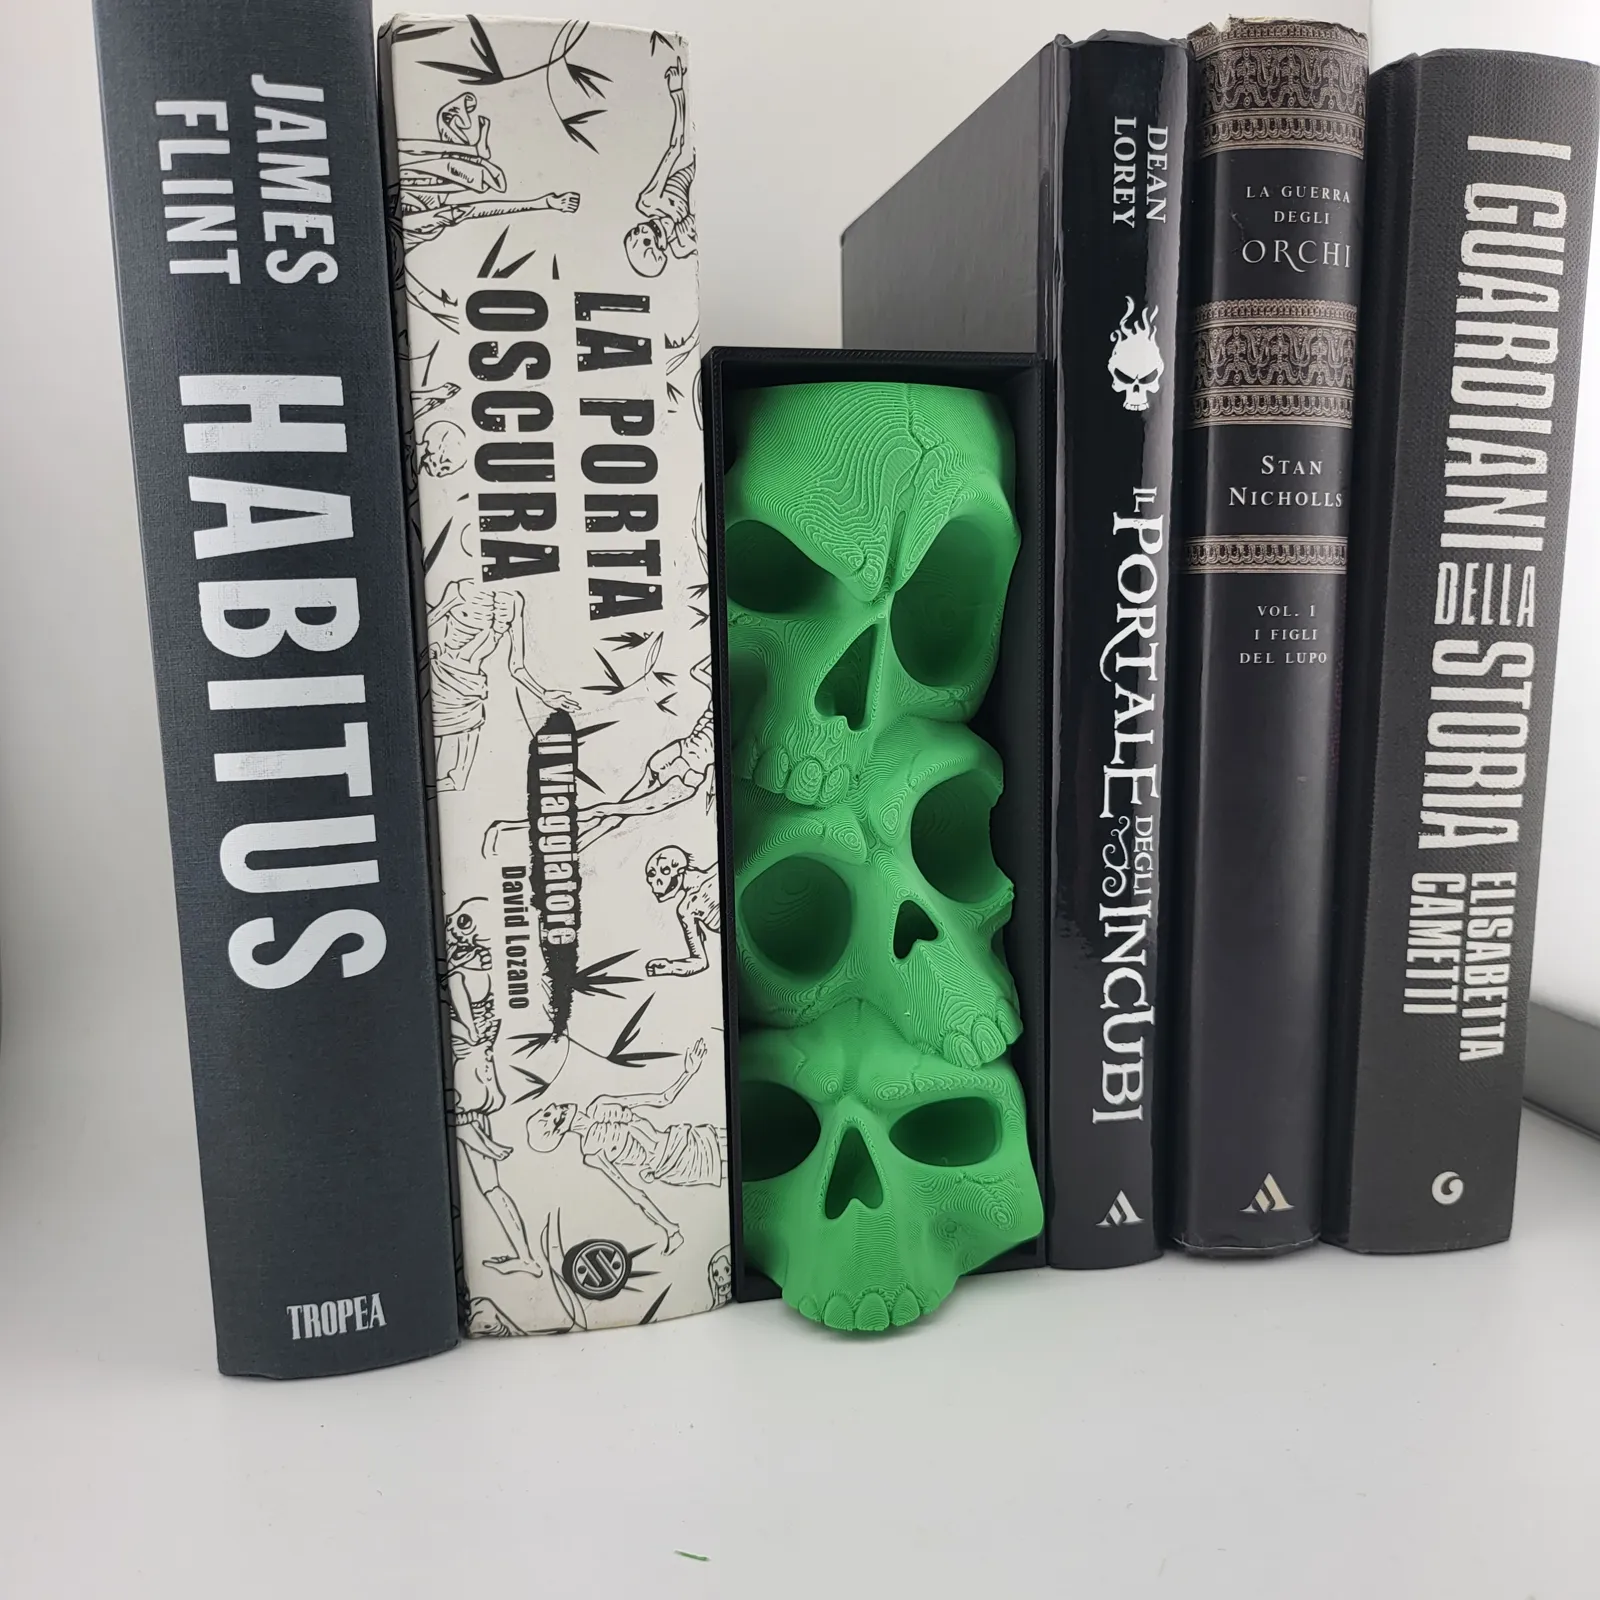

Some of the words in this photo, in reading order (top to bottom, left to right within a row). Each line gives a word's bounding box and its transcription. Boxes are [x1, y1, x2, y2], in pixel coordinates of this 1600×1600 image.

[252, 73, 338, 284] JAMES
[1112, 116, 1137, 228] LOREY
[1146, 125, 1169, 224] DEAN
[1467, 135, 1572, 161] I
[155, 100, 241, 285] FLINT
[1246, 186, 1270, 199] LA
[1280, 185, 1352, 204] GUERRA
[1274, 210, 1331, 225] DEGLI
[1241, 238, 1352, 274] ORCHI
[573, 291, 653, 372] LA
[1441, 182, 1567, 551] GUARDIANI
[465, 289, 561, 583] OSCURA
[579, 397, 664, 621] PORTA
[1133, 486, 1158, 513] IL
[1253, 628, 1261, 641] I
[1270, 628, 1319, 641] FIGLI
[1256, 605, 1301, 618] VOL.
[1434, 561, 1536, 628] DELLA
[179, 374, 387, 991] HABITUS
[1100, 511, 1164, 819] PORTALE
[1238, 652, 1276, 664] DEL
[1284, 651, 1328, 664] LUPO
[537, 733, 573, 756] Il
[1418, 640, 1536, 849] STORIA
[537, 763, 577, 946] Viaggiatore
[1133, 814, 1155, 895] DEGLI
[501, 865, 530, 928] David
[505, 934, 530, 1010] Lozano
[1403, 872, 1467, 1014] CAMETTI
[1458, 871, 1518, 1062] ELISABETTA
[1092, 901, 1156, 1124] INCUBI
[286, 1292, 387, 1340] TROPEA
